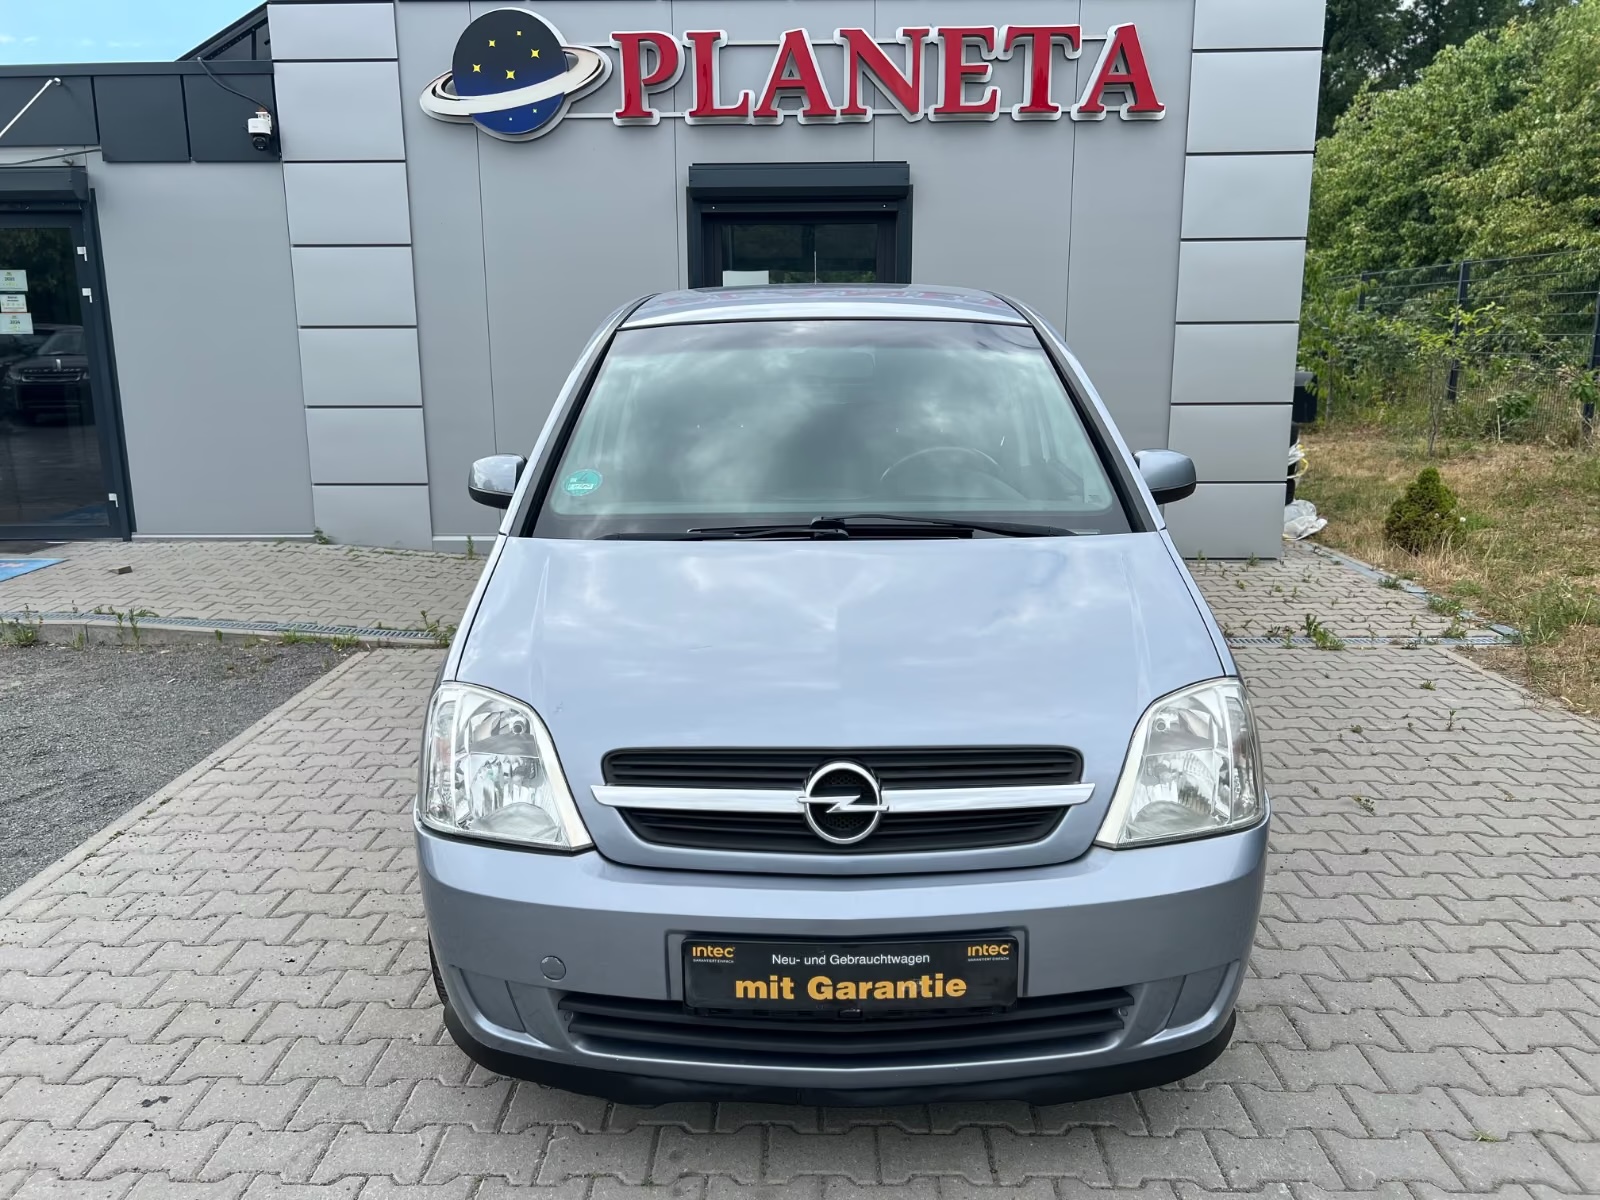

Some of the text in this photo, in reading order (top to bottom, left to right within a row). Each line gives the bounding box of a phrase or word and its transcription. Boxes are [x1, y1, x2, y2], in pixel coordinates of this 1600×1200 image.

[611, 23, 1164, 123] PLANETA
[692, 945, 735, 958] intec
[967, 943, 1010, 957] intec
[771, 953, 931, 966] Neu- und Gebrauchtwagen
[735, 973, 968, 1001] mit Garantie
